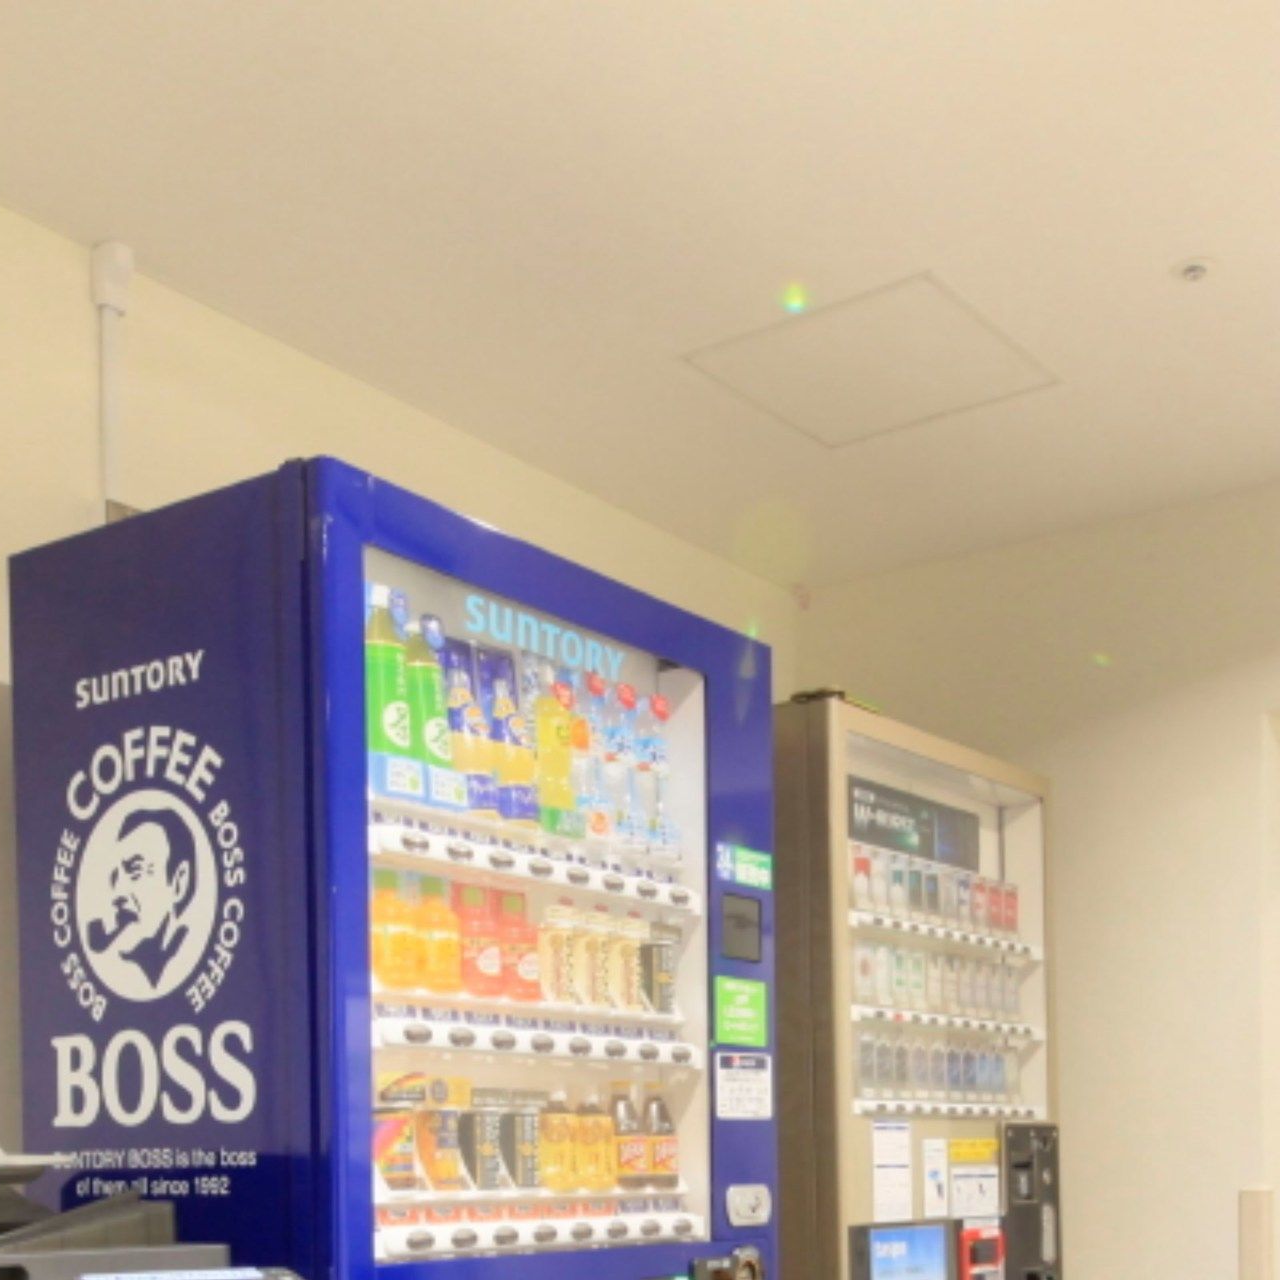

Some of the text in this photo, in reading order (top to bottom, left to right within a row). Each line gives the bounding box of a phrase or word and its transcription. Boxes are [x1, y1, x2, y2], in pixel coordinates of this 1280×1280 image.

[75, 649, 206, 710] SUNTORY
[464, 594, 627, 683] SUNTORY
[66, 725, 224, 821] COFFEE
[51, 828, 107, 1022] BOSS COFFEE
[185, 800, 246, 1014] BOSS COFFEE
[51, 1019, 257, 1127] BOSS
[126, 1147, 174, 1170] BOSS
[175, 1148, 190, 1169] is
[191, 1146, 217, 1169] the
[220, 1144, 258, 1168] boss
[149, 1176, 190, 1196] since
[194, 1174, 232, 1196] 1992
